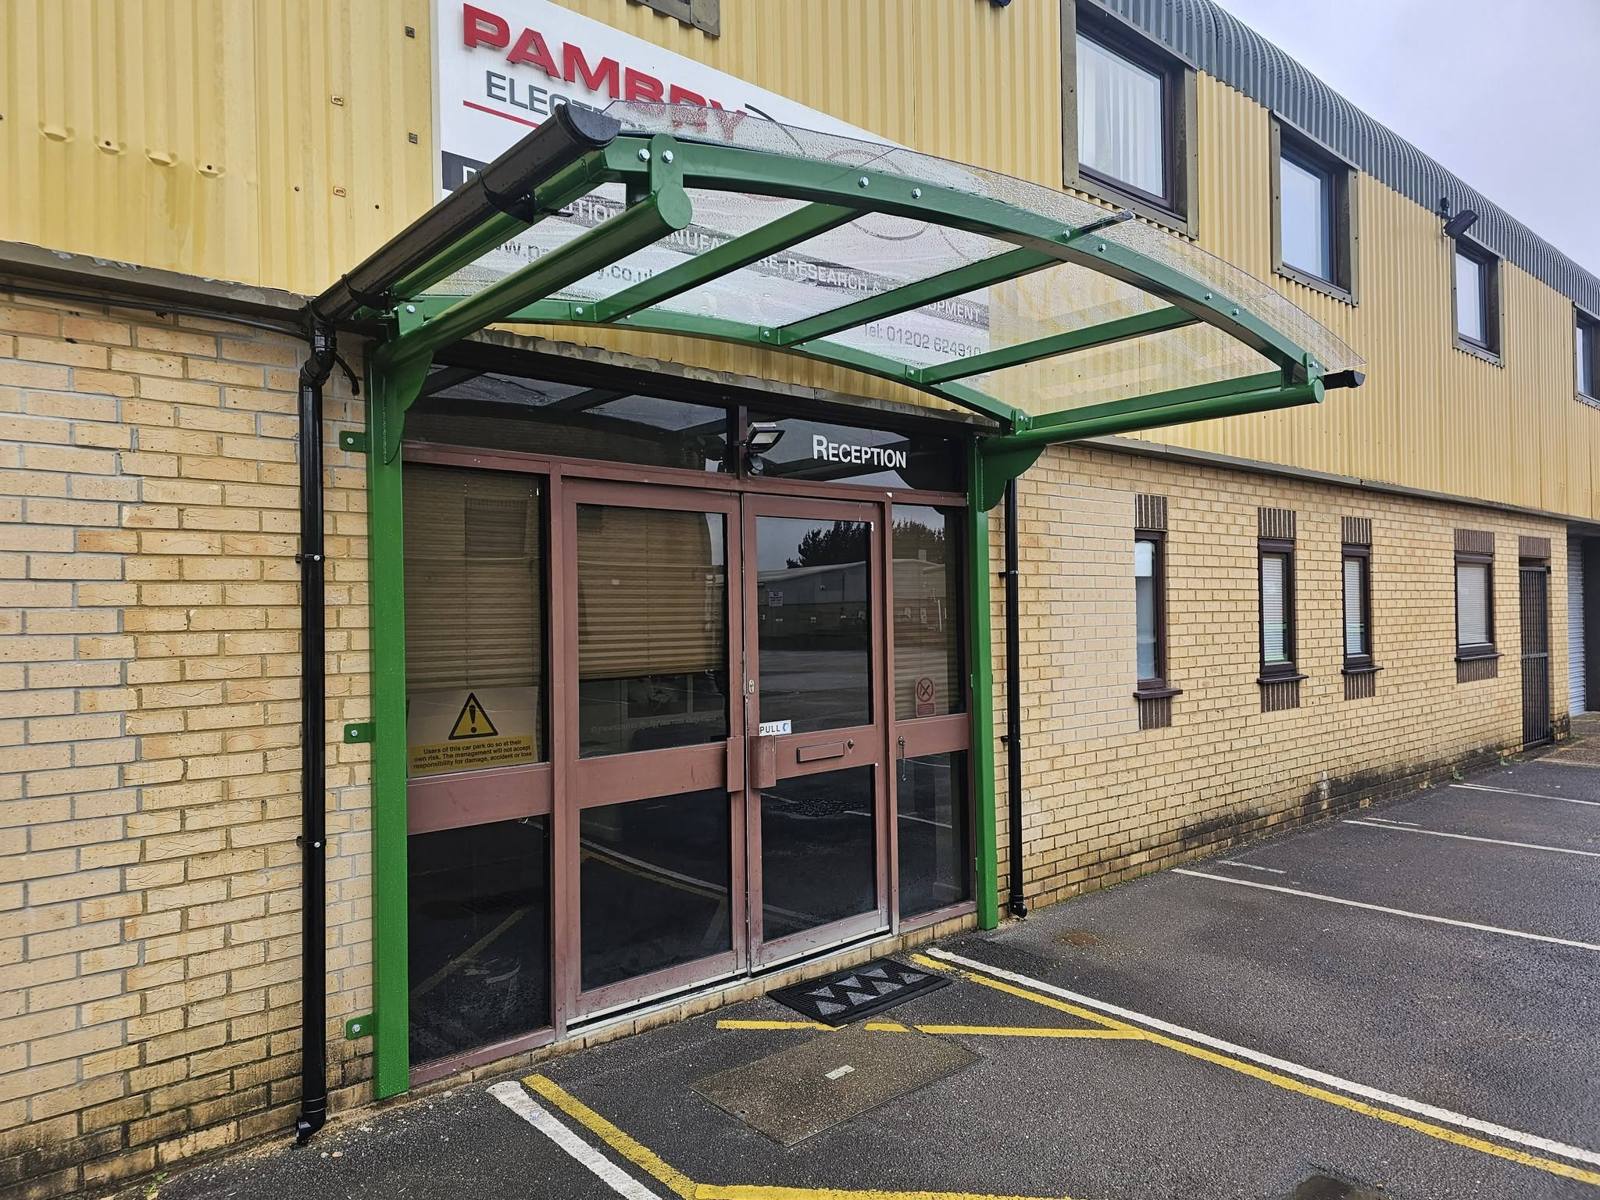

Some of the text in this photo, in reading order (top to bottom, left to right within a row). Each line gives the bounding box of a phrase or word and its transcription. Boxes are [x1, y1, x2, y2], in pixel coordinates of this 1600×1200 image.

[463, 3, 748, 141] PAMBRY
[788, 258, 869, 293] RESEARCH
[886, 326, 930, 349] 01202
[933, 337, 981, 358] 624910
[759, 725, 781, 735] PULL
[423, 747, 441, 755] Users
[473, 743, 485, 751] park
[455, 749, 492, 759] management
[493, 746, 503, 754] will
[513, 744, 531, 753] accept
[413, 758, 454, 769] responsibility
[455, 756, 464, 764] for
[490, 752, 513, 761] accident
